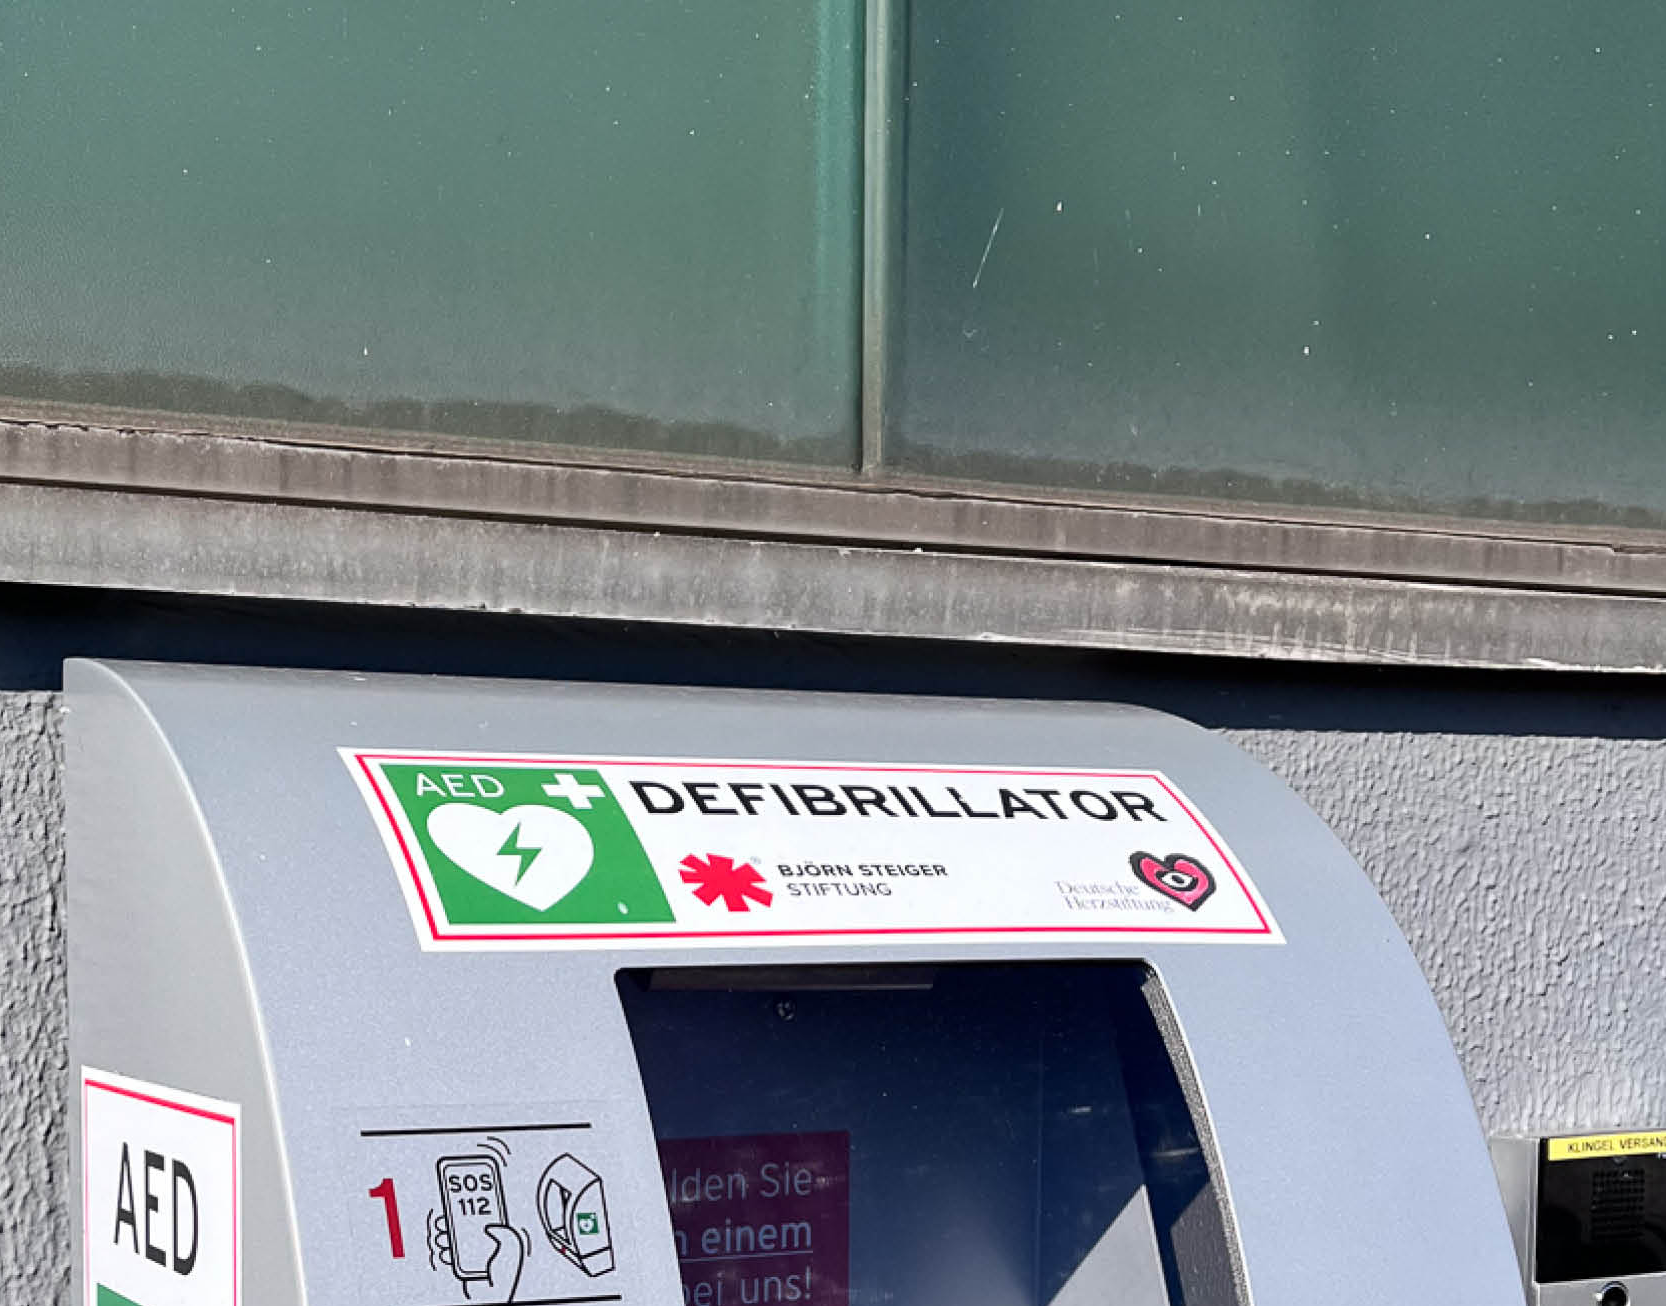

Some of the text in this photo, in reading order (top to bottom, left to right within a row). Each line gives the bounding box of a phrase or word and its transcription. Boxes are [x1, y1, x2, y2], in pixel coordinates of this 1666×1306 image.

[416, 772, 505, 798] AED
[629, 780, 1168, 822] DEFIBRILLATOR
[777, 861, 949, 876] BJÖRN STEIGER
[786, 882, 893, 897] STIFTUNG
[1567, 1139, 1613, 1153] KLINGEL
[448, 1174, 494, 1194] SOS
[670, 1162, 812, 1203] lden Sie
[114, 1142, 198, 1276] AED
[368, 1178, 406, 1260] 1
[458, 1197, 492, 1216] 112
[701, 1218, 812, 1254] einem
[740, 1266, 812, 1304] uns!
